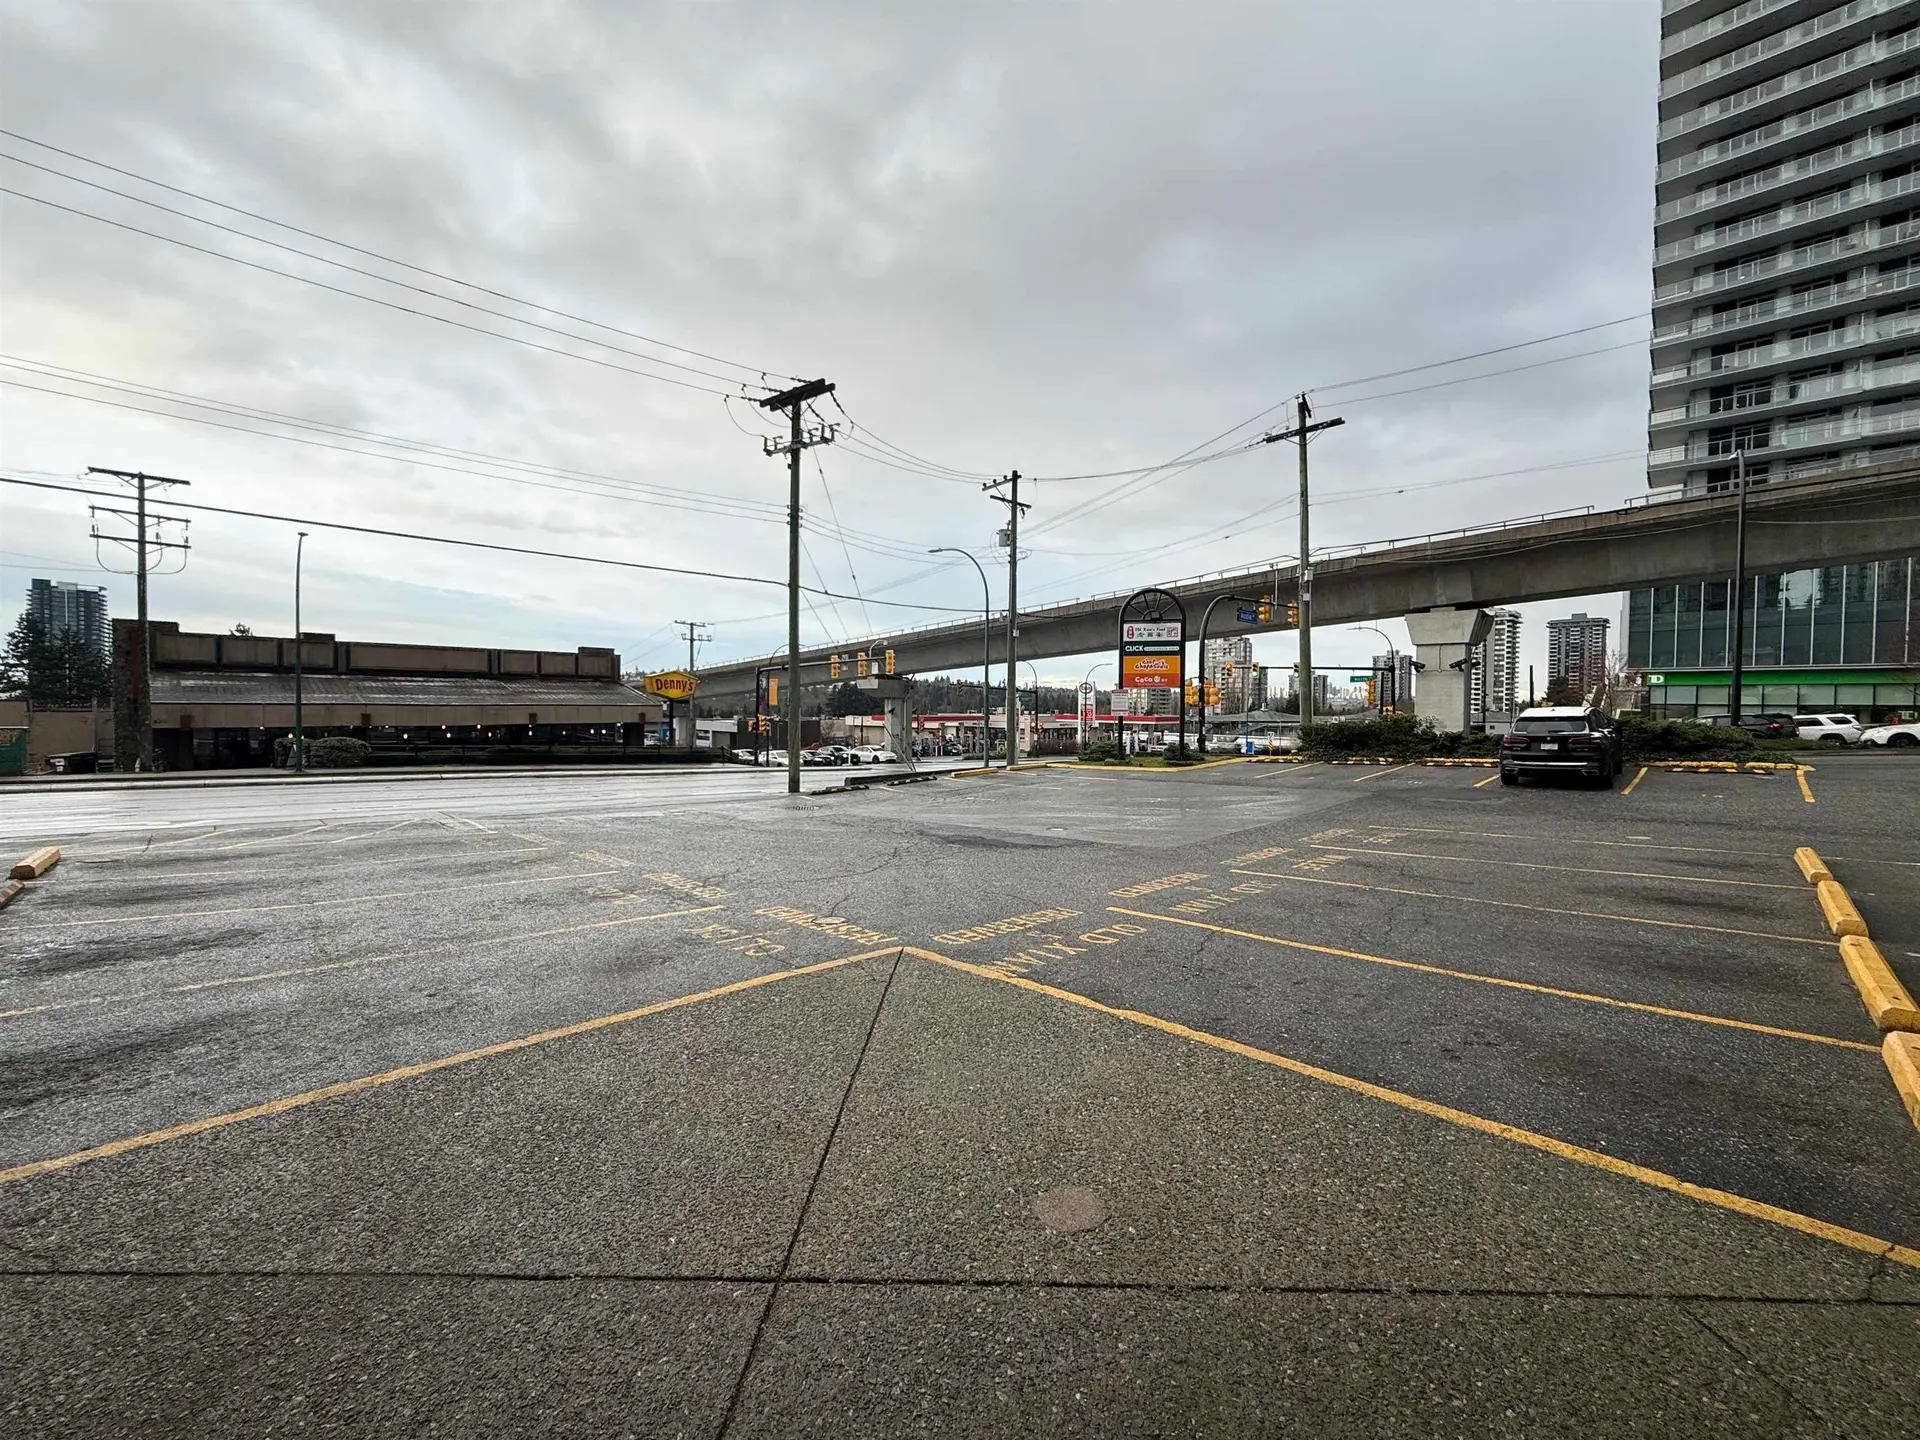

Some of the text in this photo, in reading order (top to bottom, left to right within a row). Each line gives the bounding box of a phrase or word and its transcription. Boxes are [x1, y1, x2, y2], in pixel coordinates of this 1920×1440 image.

[655, 678, 694, 692] Denny's
[1648, 674, 1664, 683] TD
[932, 906, 1084, 945] RESERVED
[980, 924, 1148, 978] OLD XIAN
